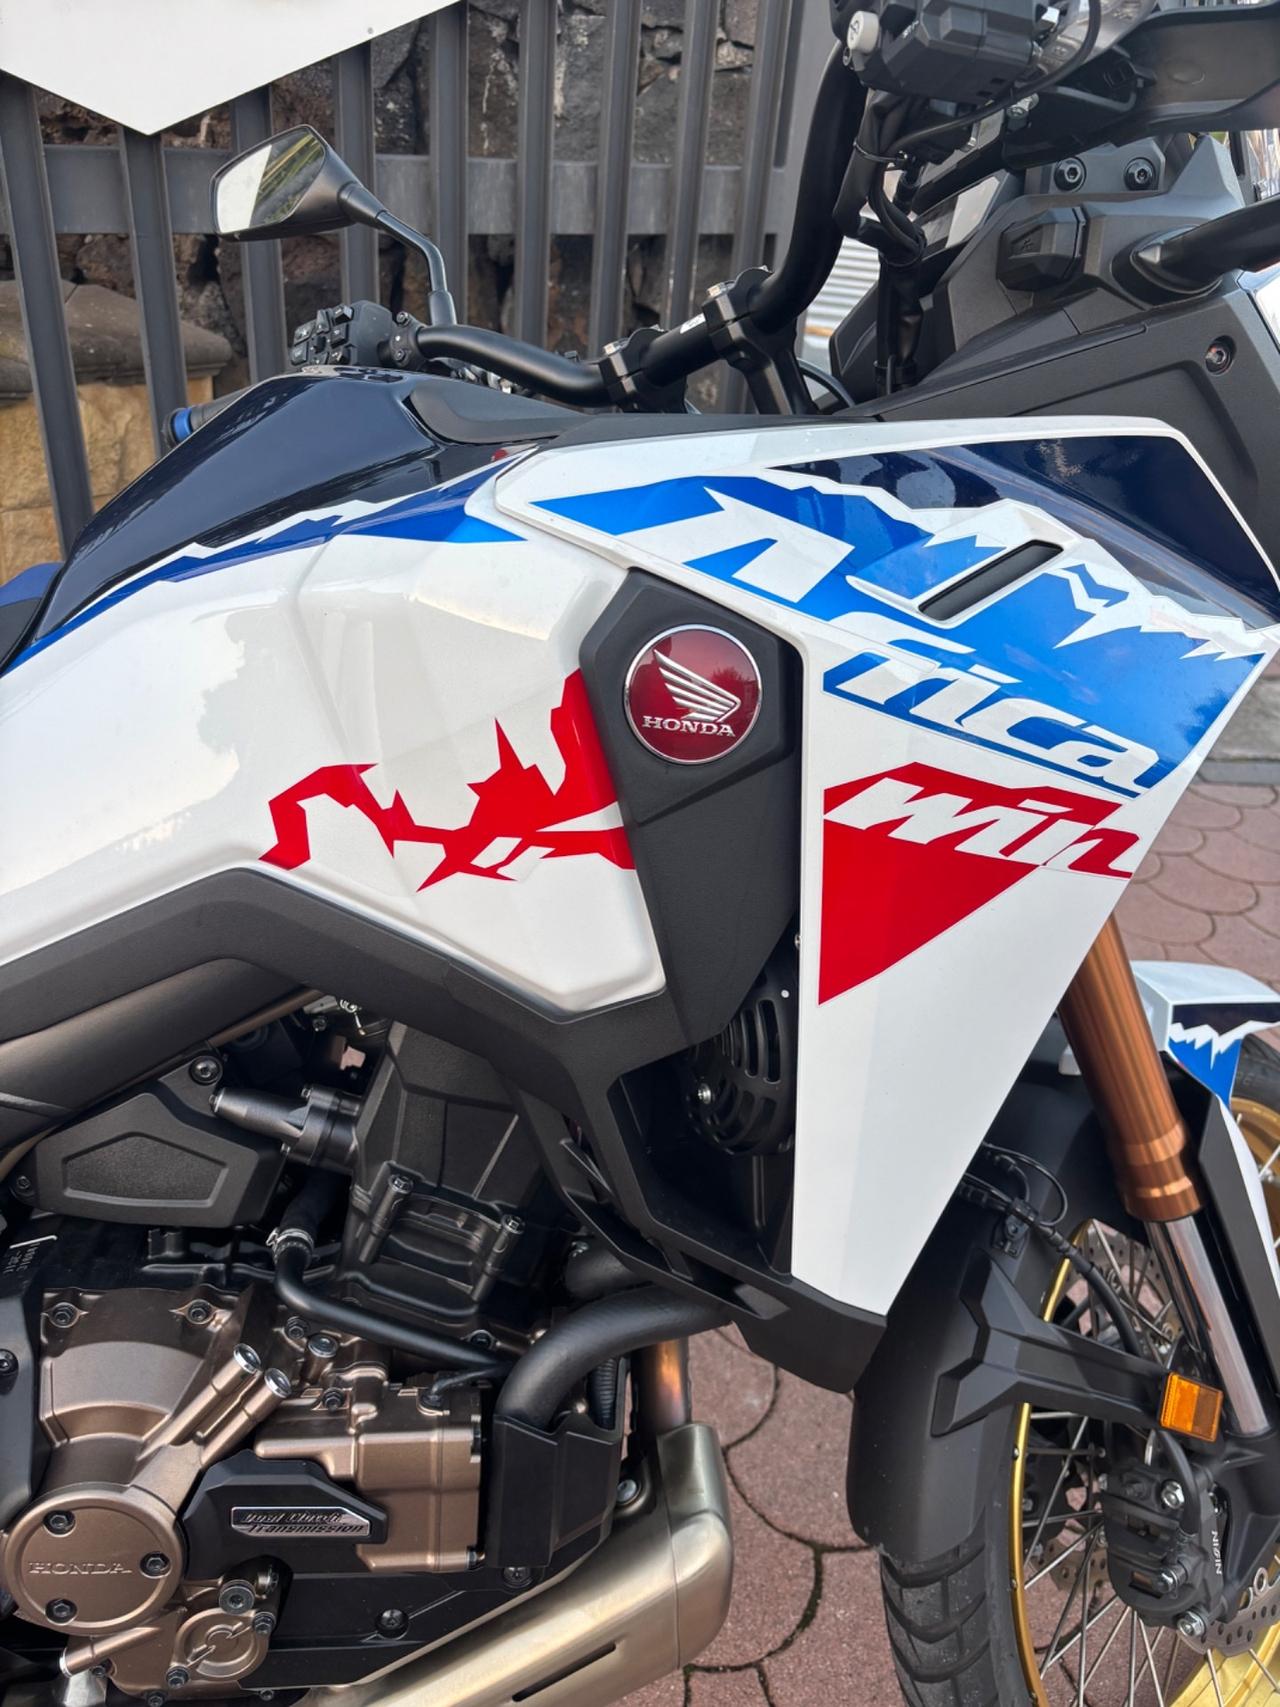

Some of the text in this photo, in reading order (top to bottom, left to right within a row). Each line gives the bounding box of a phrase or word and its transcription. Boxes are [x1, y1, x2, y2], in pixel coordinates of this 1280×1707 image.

[642, 716, 735, 737] HONDA
[249, 1524, 364, 1533] Transmission
[28, 1562, 132, 1575] HONDA
